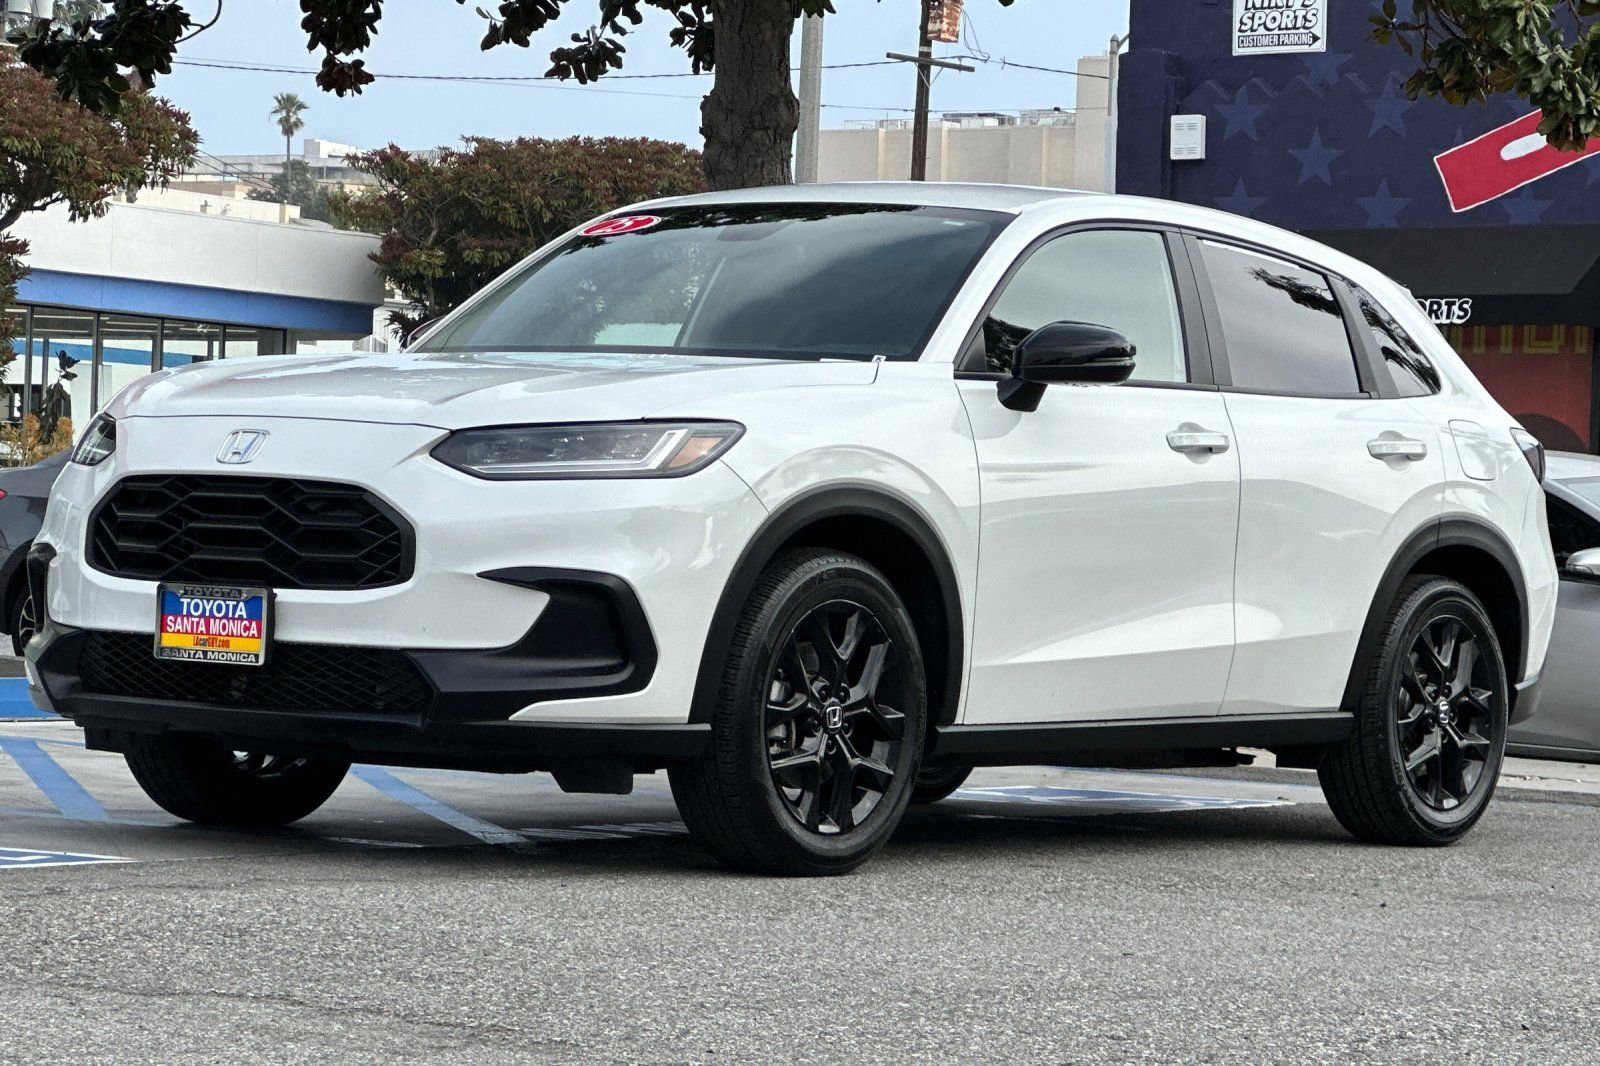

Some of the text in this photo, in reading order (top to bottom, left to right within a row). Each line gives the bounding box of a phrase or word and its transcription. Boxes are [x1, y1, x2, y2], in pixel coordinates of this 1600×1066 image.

[1238, 8, 1319, 33] SPORTS
[1239, 33, 1313, 47] CUSTOMER PARKING
[185, 587, 239, 598] TOYOTA
[180, 598, 247, 619] TOYOTA
[166, 615, 258, 637] SANTA MONICA
[162, 648, 256, 663] SANTA MONICA
